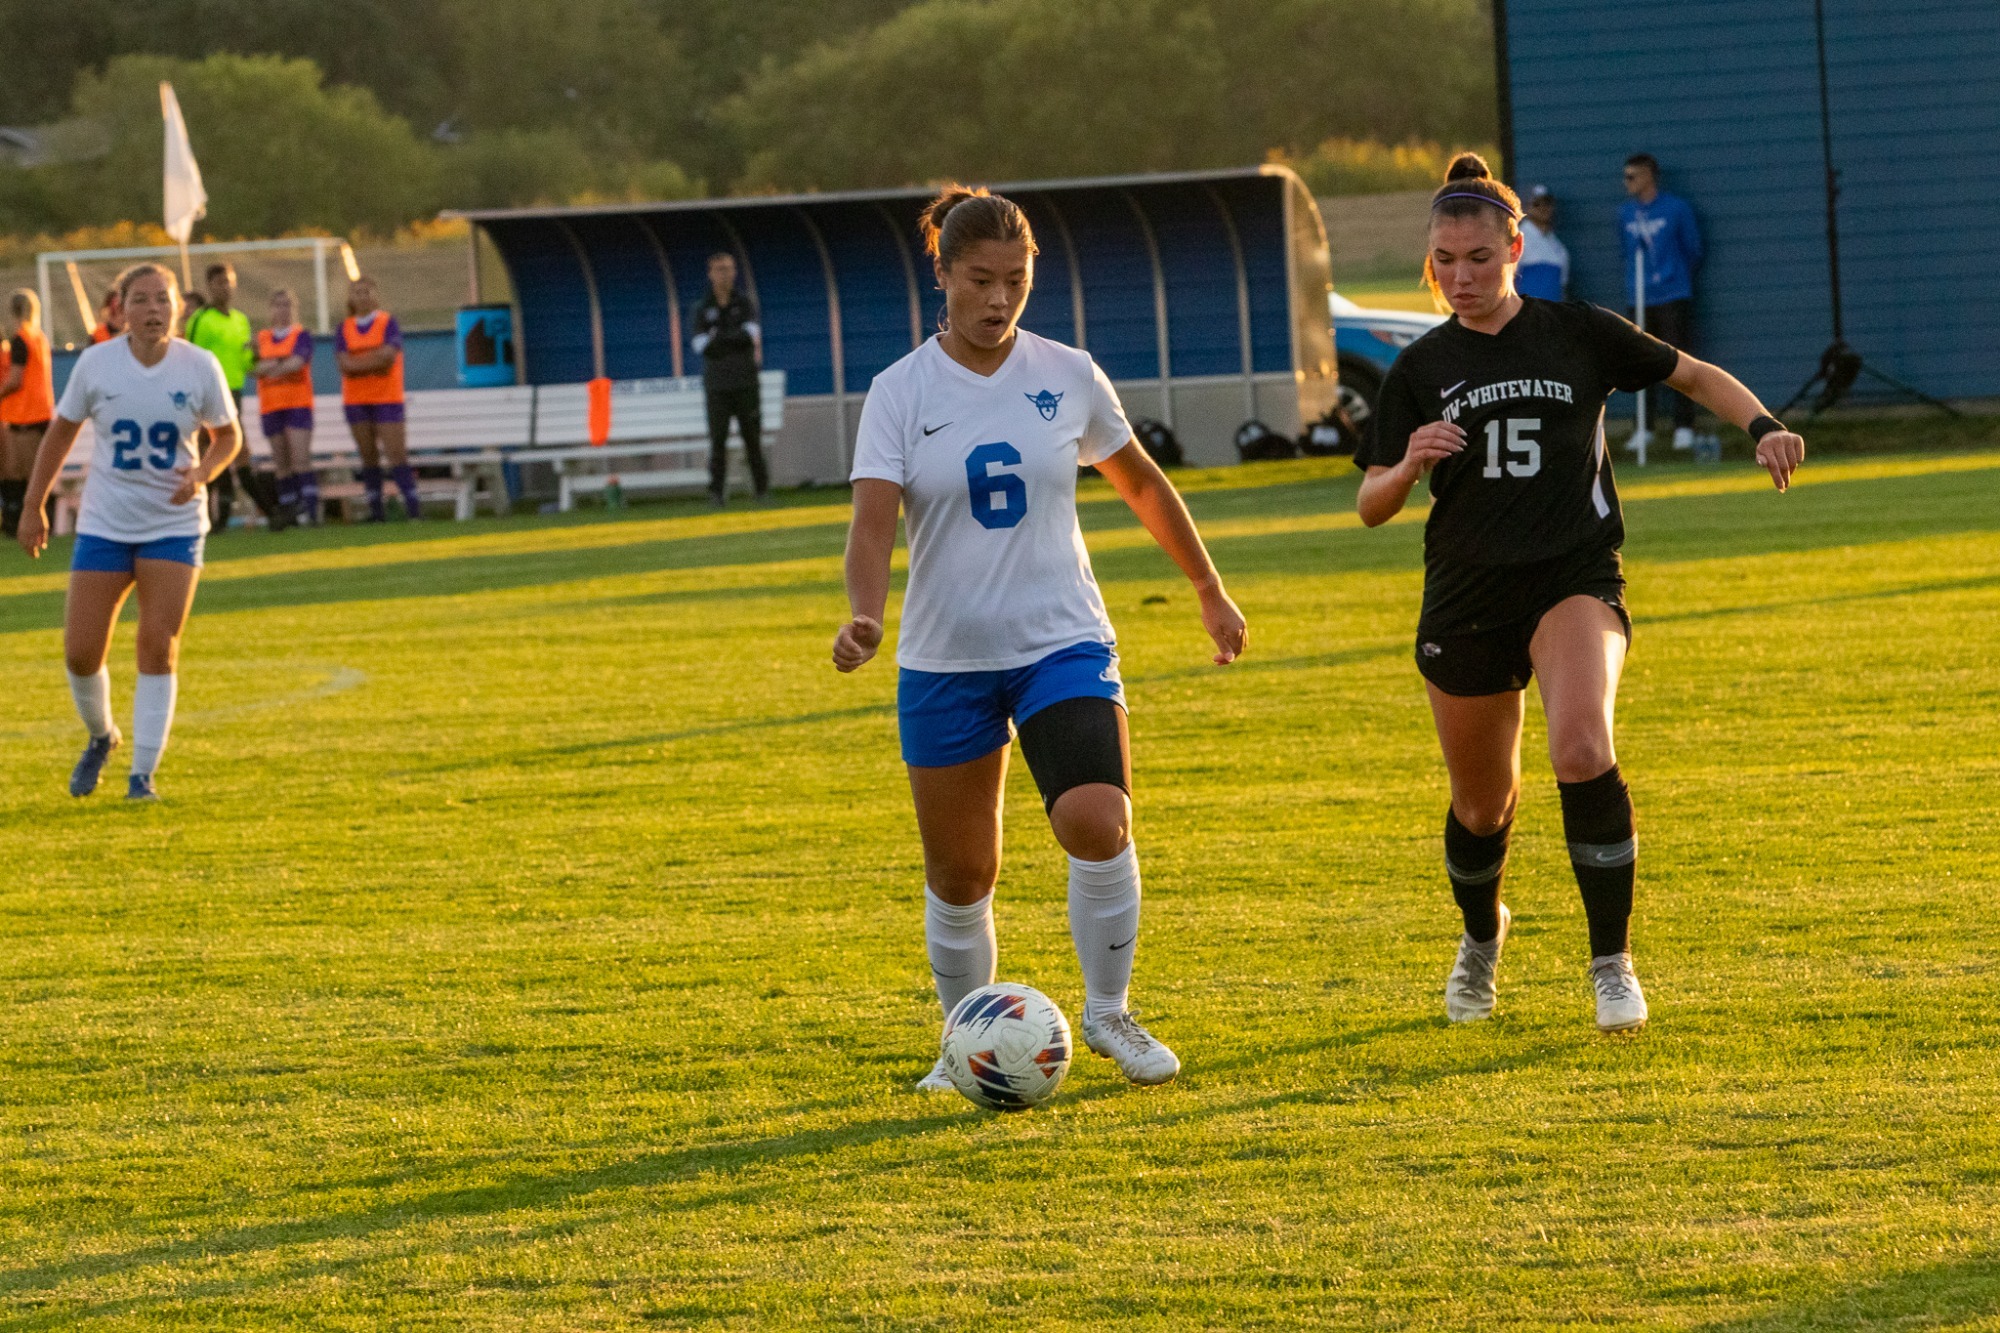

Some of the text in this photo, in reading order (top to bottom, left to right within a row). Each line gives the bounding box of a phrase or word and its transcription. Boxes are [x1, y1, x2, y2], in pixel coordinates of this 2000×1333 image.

[1441, 378, 1573, 424] UW-WHITEWATER
[111, 418, 180, 471] 29
[1483, 418, 1541, 479] 15
[965, 441, 1028, 530] 6
